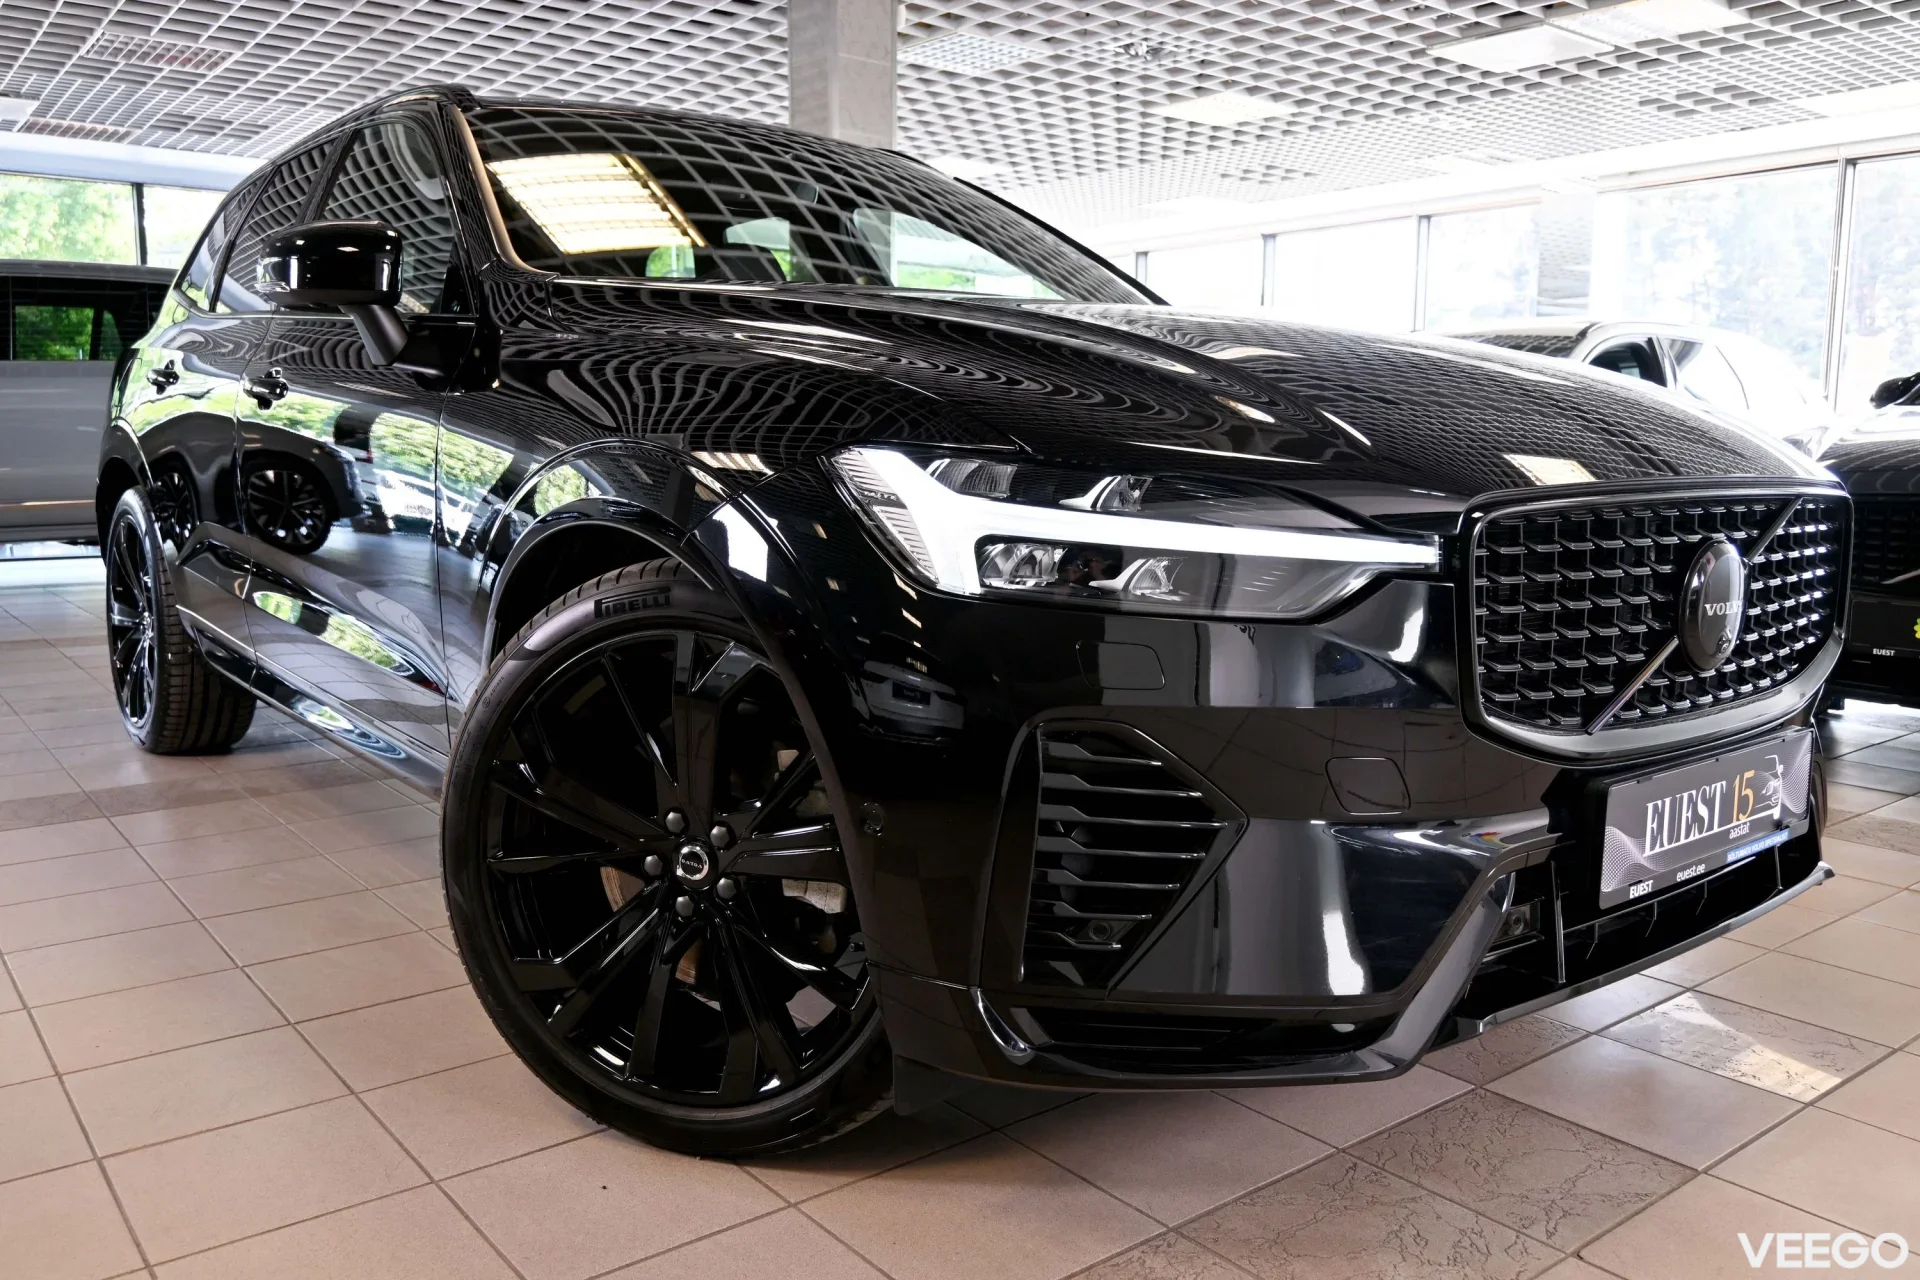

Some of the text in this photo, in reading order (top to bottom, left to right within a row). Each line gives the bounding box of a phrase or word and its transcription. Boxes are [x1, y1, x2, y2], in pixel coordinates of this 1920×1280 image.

[594, 586, 671, 618] PIRELLI
[1704, 600, 1743, 616] VOLV
[1872, 648, 1895, 656] EUEST
[1643, 770, 1755, 857] EUEST 15
[1729, 821, 1750, 839] aastat
[681, 858, 703, 869] VOLVO
[1676, 863, 1706, 882] euest.ee
[1629, 880, 1654, 899] EUEST
